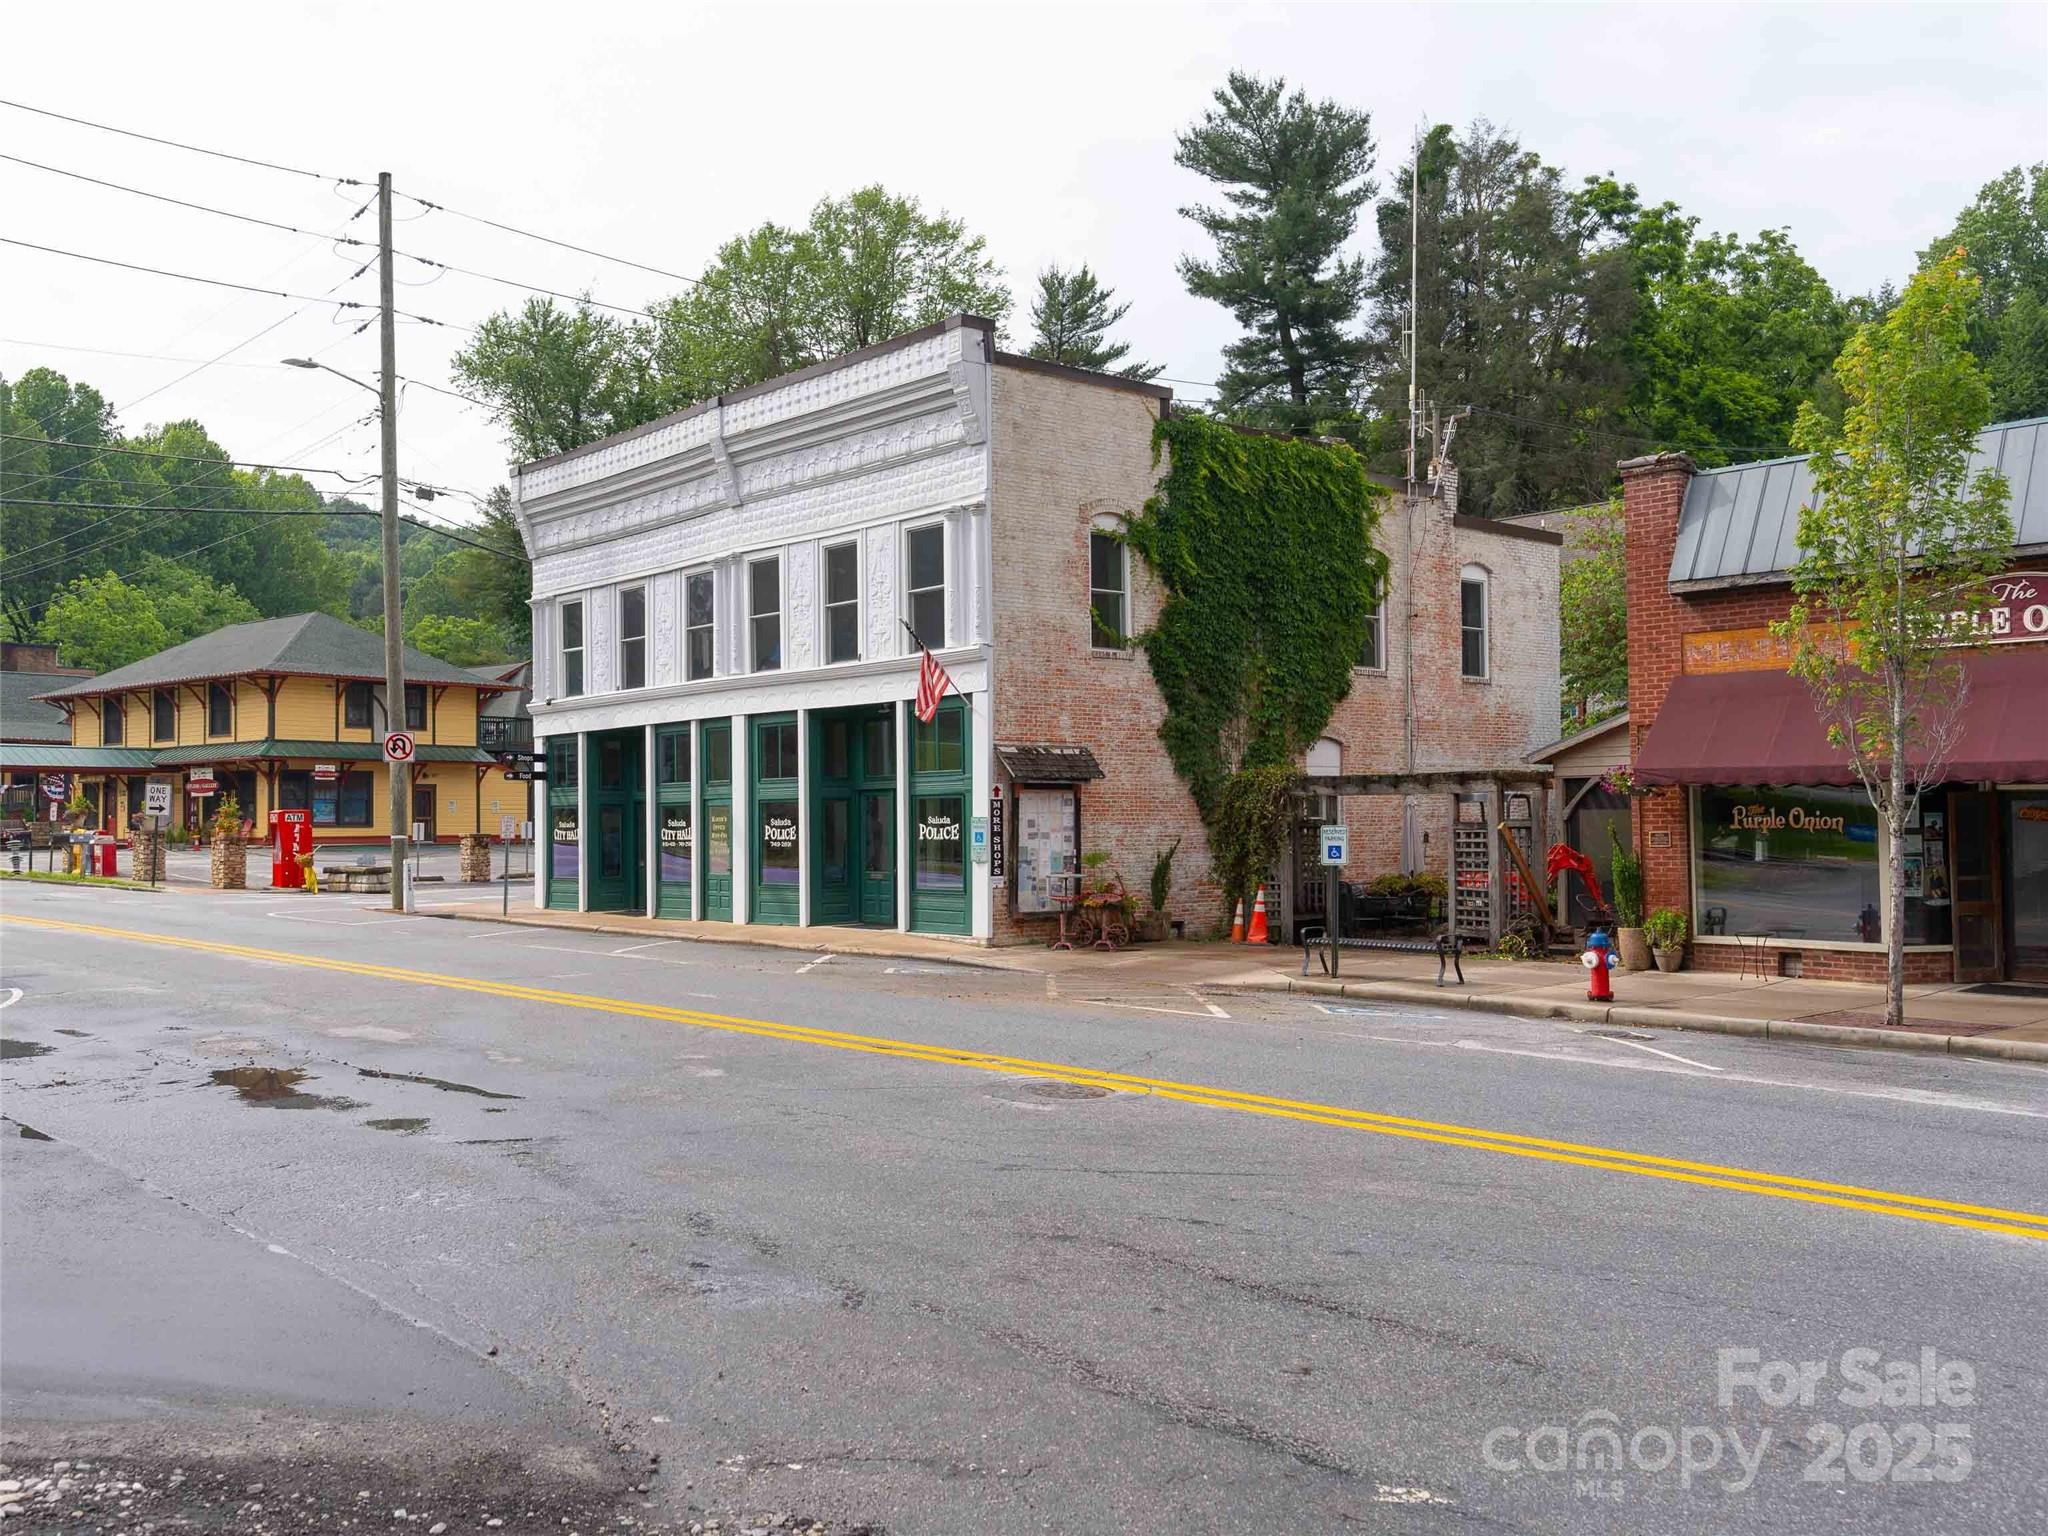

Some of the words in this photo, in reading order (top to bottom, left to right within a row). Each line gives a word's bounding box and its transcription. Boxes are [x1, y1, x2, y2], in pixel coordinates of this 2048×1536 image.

[1992, 579, 2038, 601] The
[517, 754, 533, 762] Shops
[150, 786, 167, 795] ONE
[149, 795, 167, 803] WAY
[771, 818, 791, 826] Saluda
[928, 816, 951, 824] Saluda
[993, 801, 1001, 832] MORE
[1729, 805, 1785, 834] Purple
[1788, 807, 1844, 833] Onion
[668, 819, 686, 827] Saluda
[554, 829, 567, 840] CITY
[661, 828, 676, 840] CITY
[765, 825, 796, 840] POLICE
[919, 823, 959, 840] POLICE
[993, 836, 1001, 875] SHOPS
